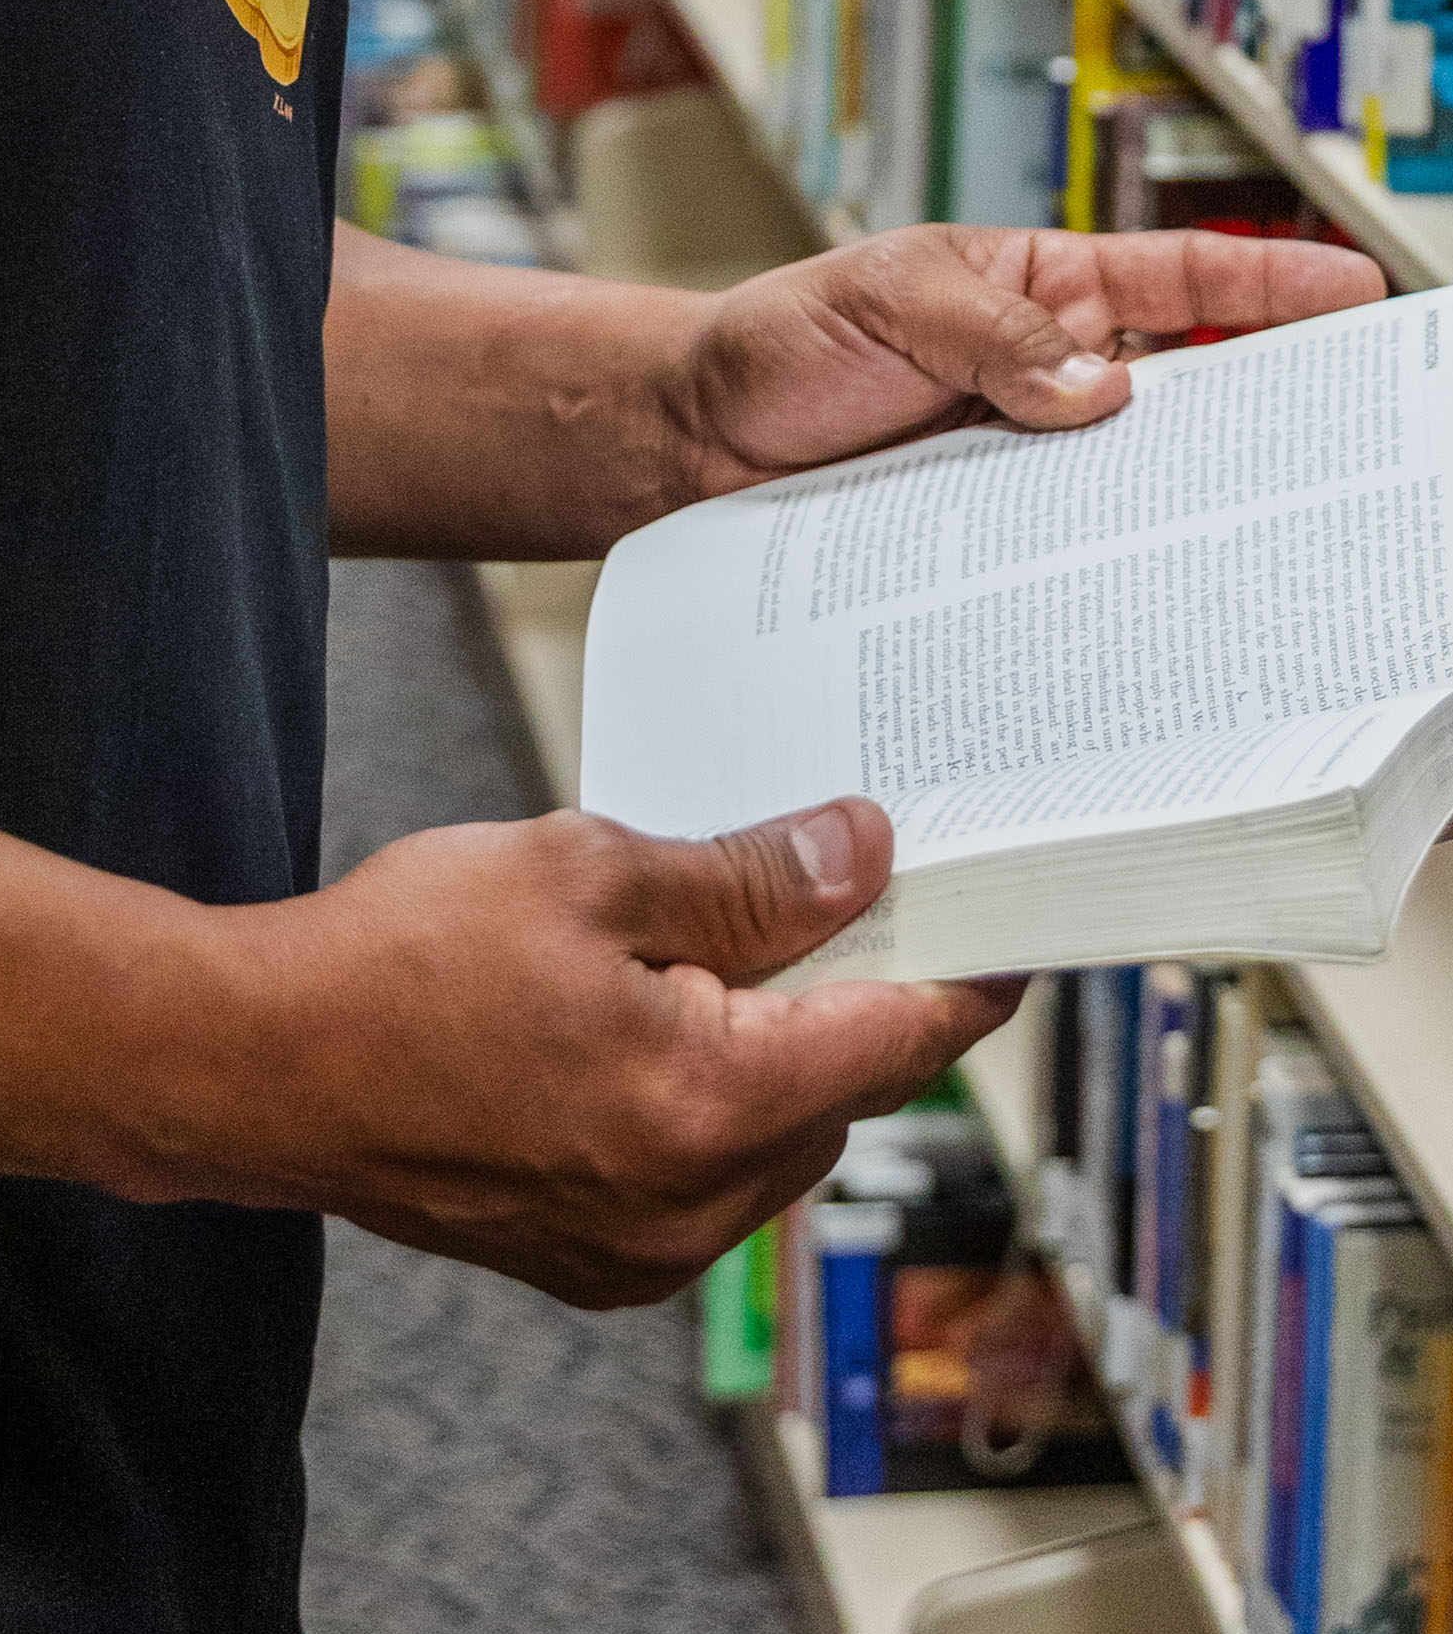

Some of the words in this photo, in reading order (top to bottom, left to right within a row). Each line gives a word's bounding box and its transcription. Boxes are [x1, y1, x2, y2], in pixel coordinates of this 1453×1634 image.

[1256, 654, 1273, 706] strengths
[1369, 667, 1387, 701] social
[1386, 655, 1402, 695] under-
[1403, 644, 1420, 690] believe
[1423, 654, 1437, 684] have
[1130, 681, 1147, 719] people
[1171, 702, 1183, 730] term
[1204, 676, 1220, 723] exercise
[1064, 700, 1078, 749] thinking
[1191, 710, 1203, 732] We
